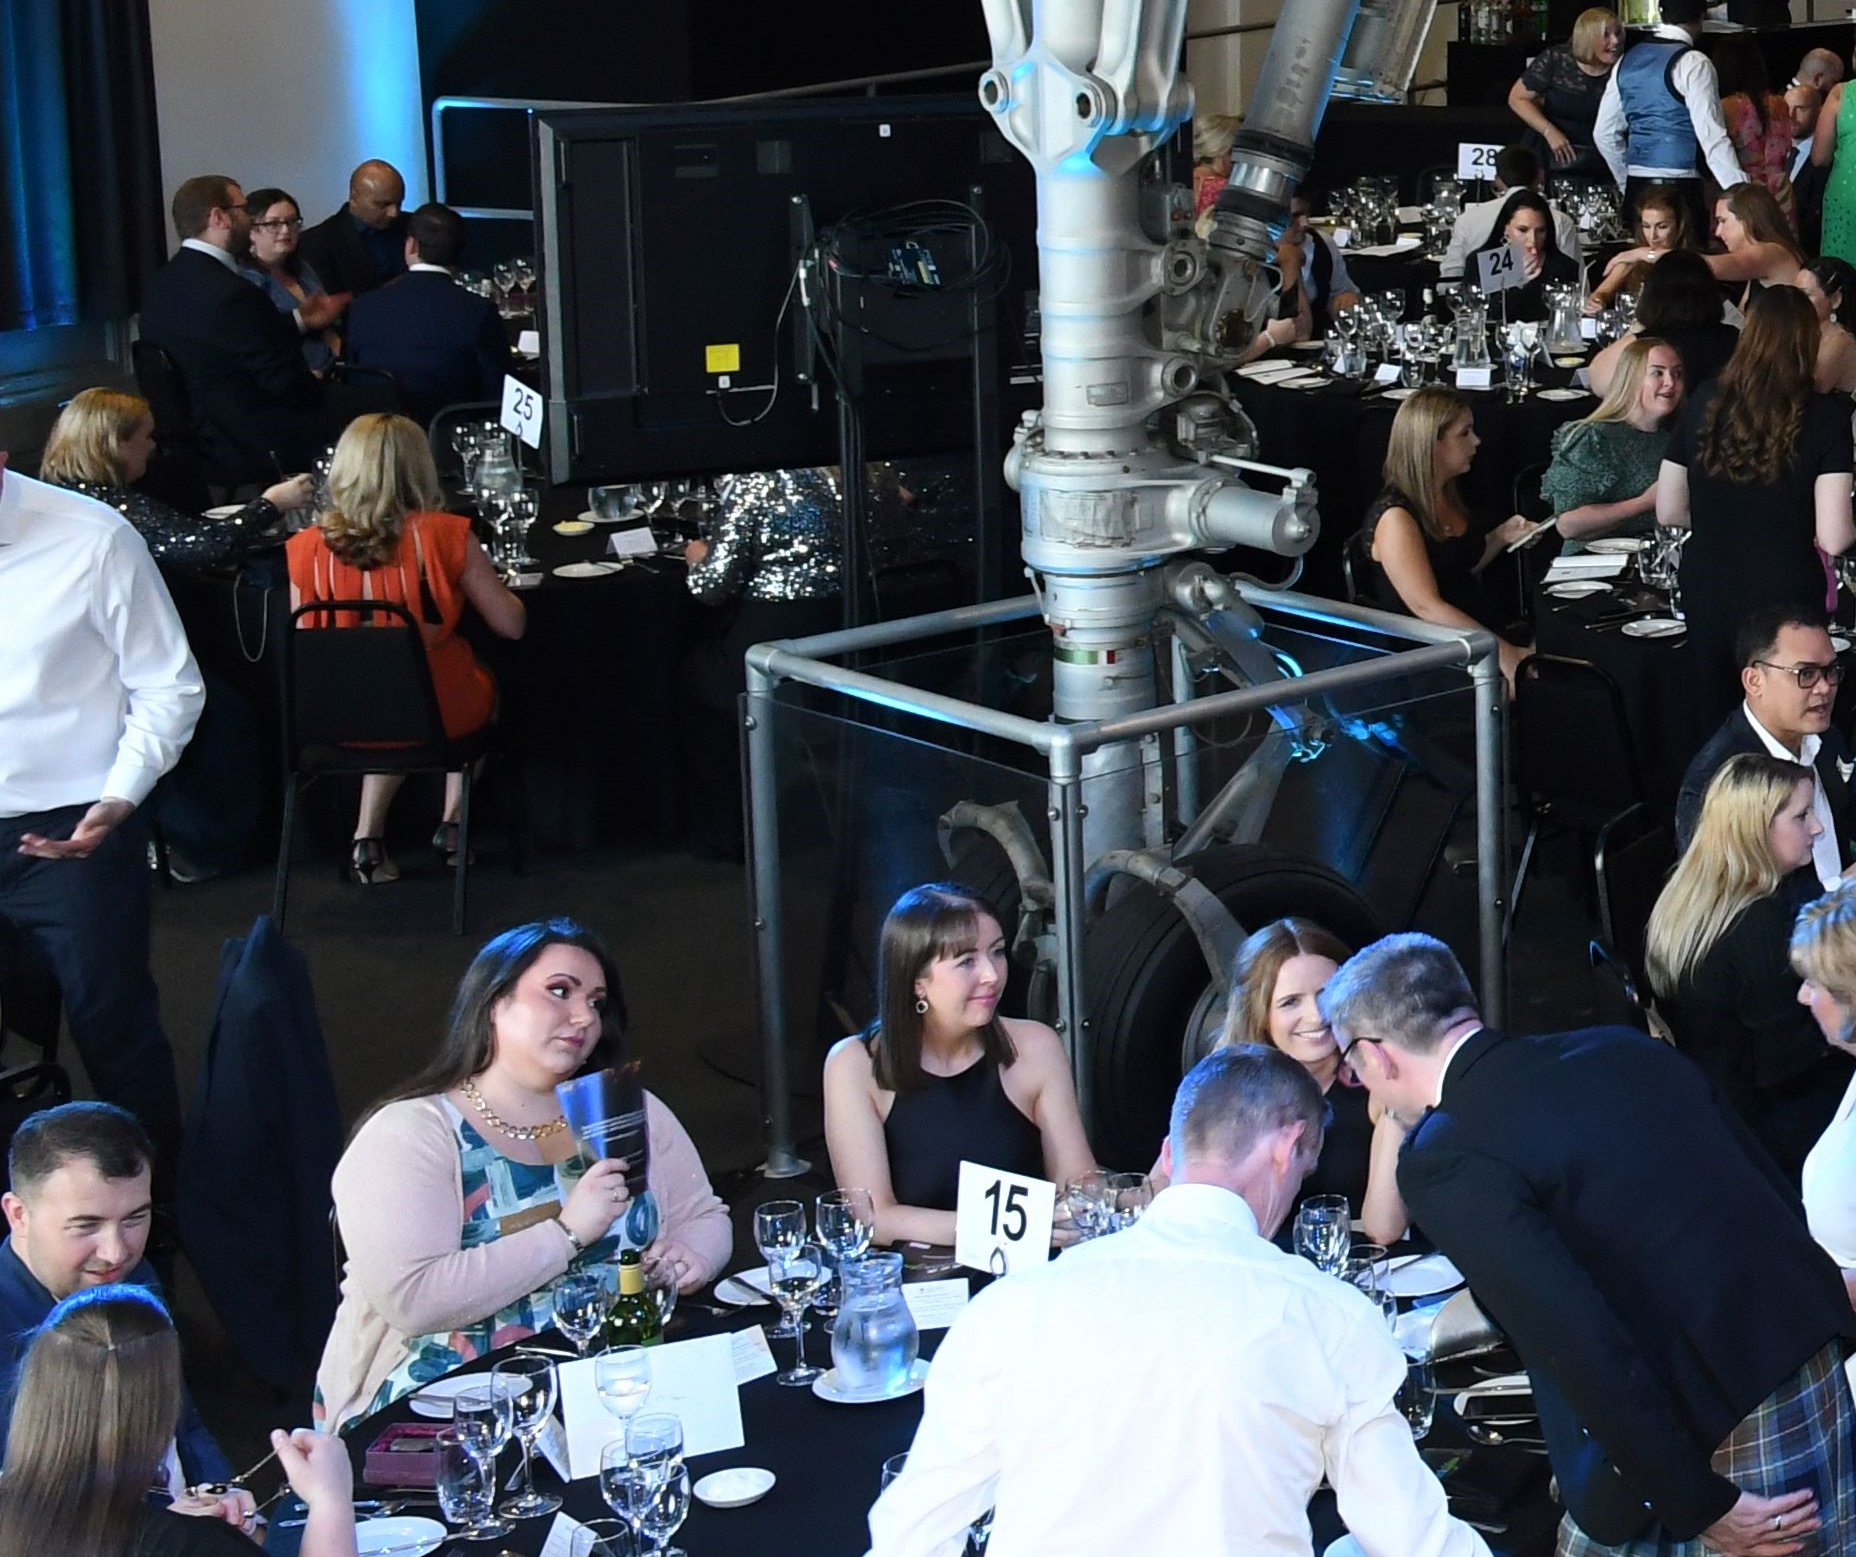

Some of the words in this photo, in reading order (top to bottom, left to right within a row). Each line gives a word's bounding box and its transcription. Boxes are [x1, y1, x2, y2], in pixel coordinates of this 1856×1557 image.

[1472, 147, 1497, 167] 28
[1490, 250, 1514, 275] 24
[512, 387, 534, 421] 25
[984, 1179, 1029, 1242] 15
